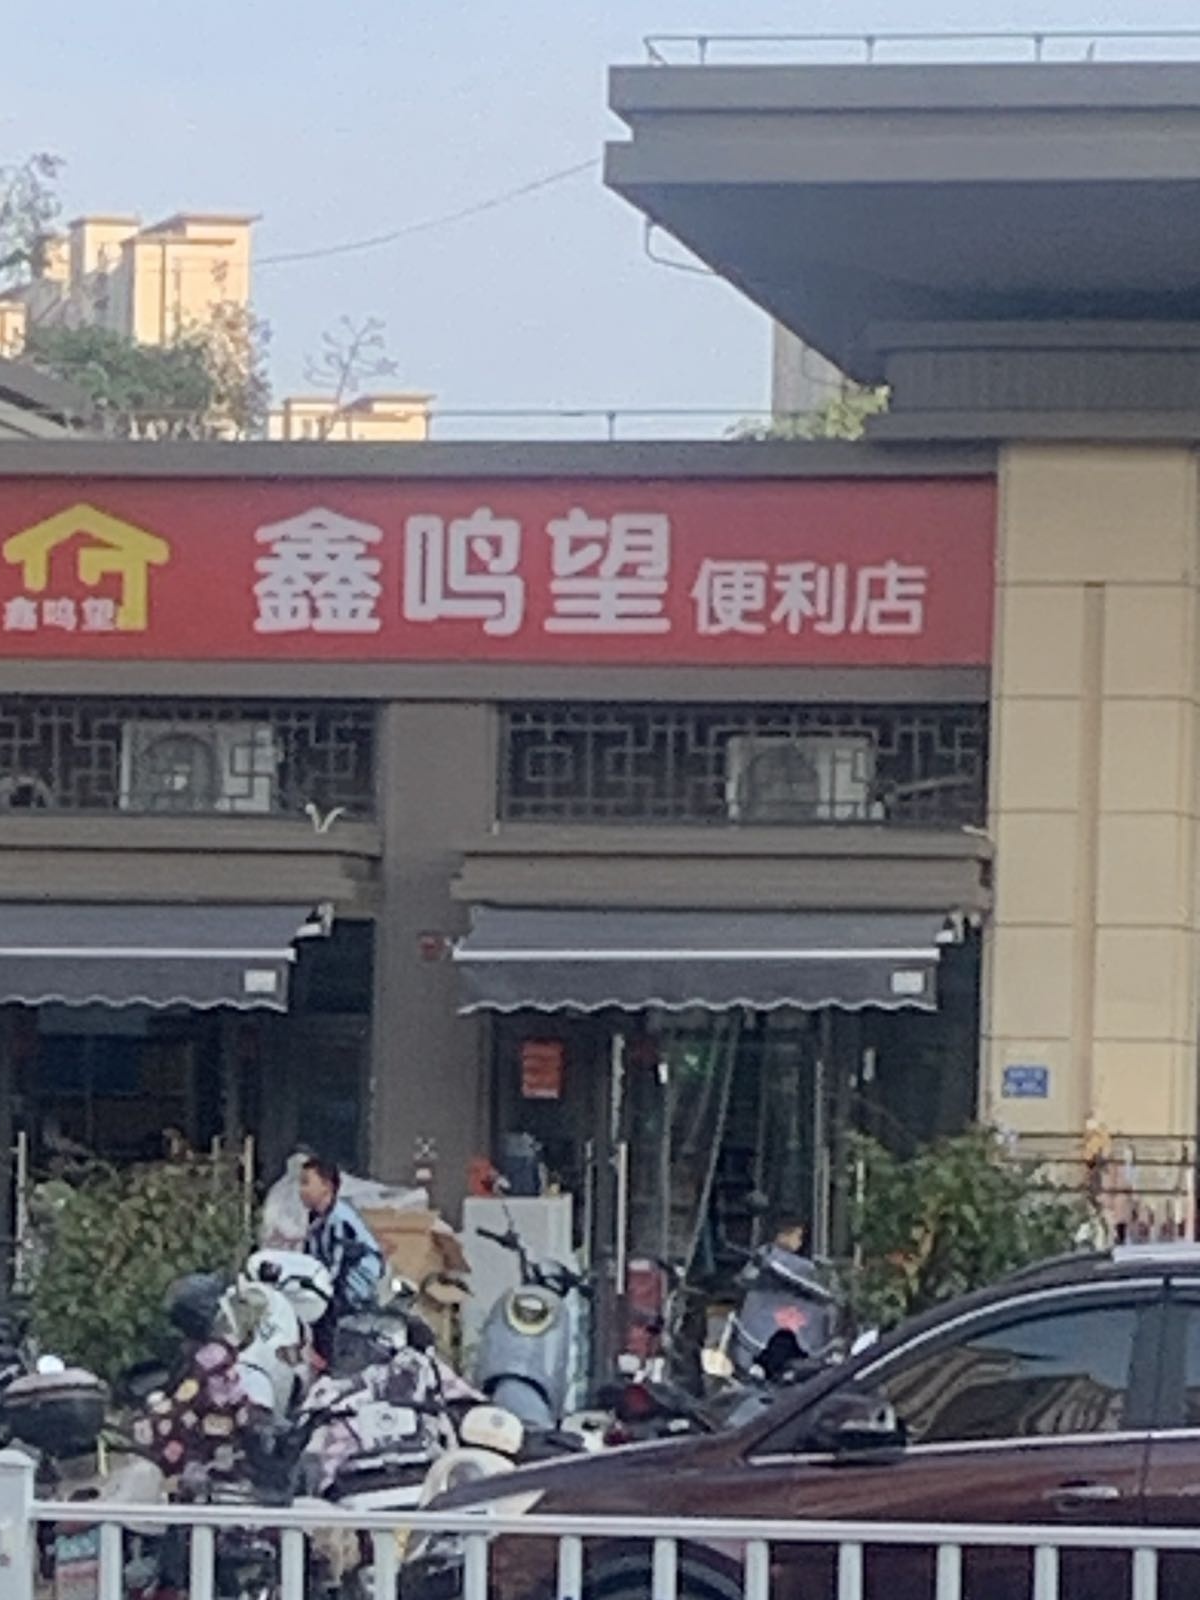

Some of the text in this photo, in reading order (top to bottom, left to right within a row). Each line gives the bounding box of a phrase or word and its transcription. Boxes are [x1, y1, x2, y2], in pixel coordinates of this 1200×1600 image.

[253, 508, 927, 636] 鑫鸣望 便利店
